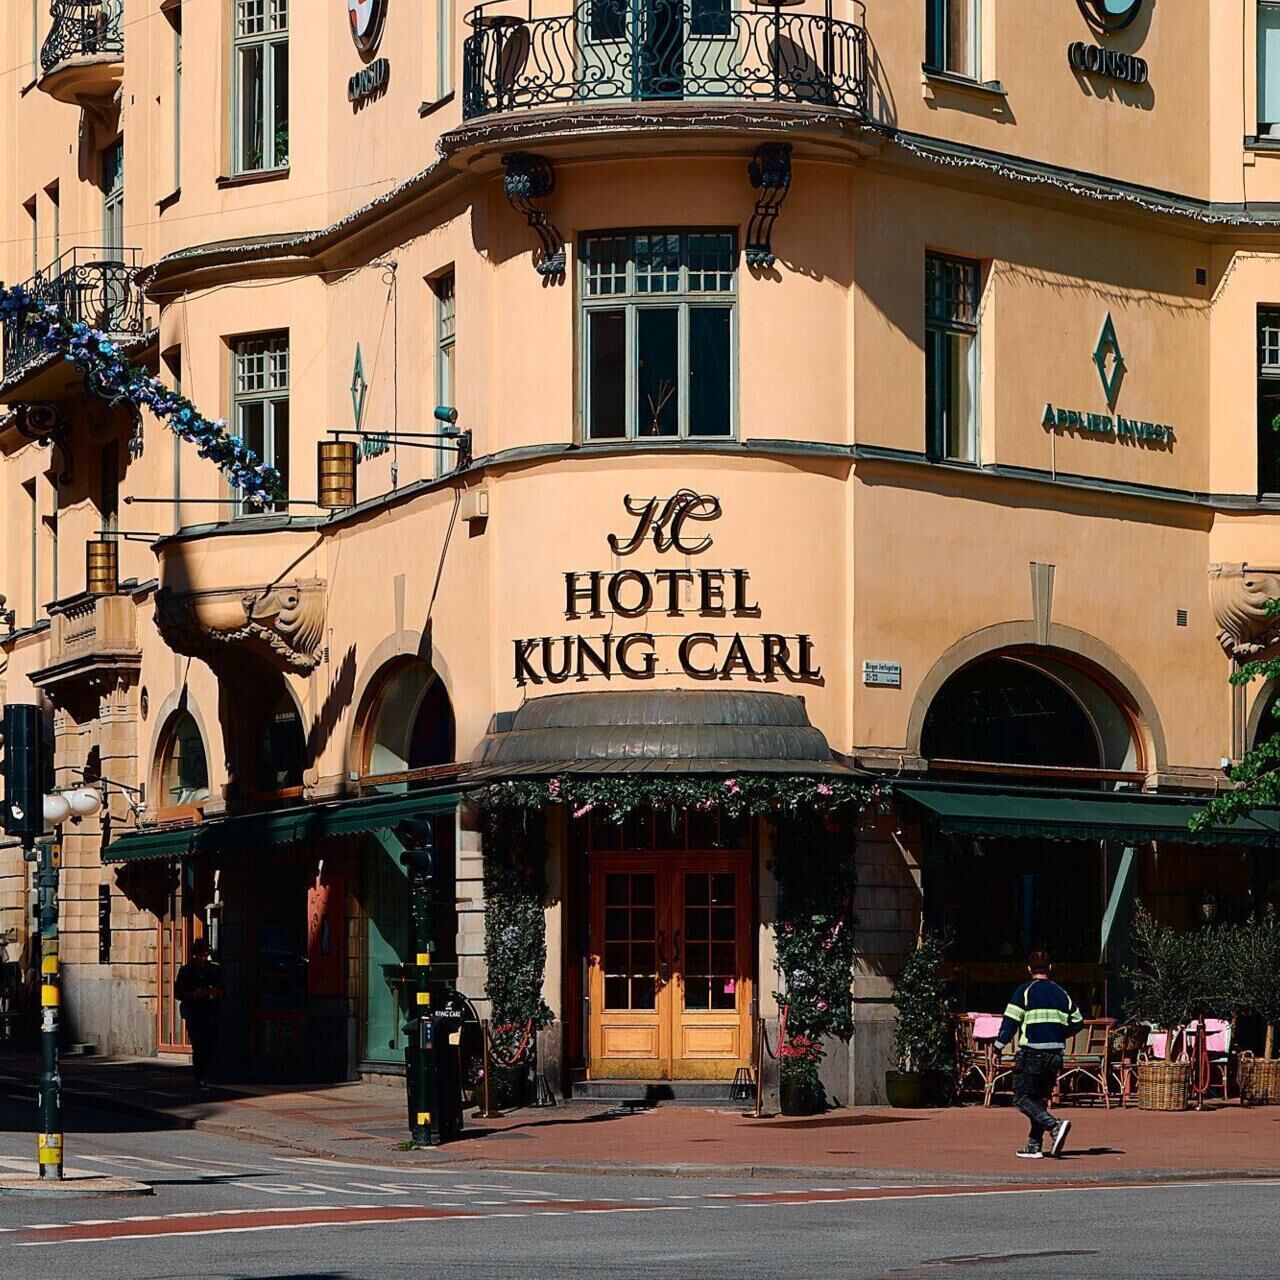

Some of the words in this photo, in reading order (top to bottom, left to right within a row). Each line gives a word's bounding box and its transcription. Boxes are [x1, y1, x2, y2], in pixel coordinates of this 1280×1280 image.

[1067, 41, 1148, 84] CONSID
[563, 568, 760, 619] HOTEL
[512, 633, 659, 685] KUNG
[678, 632, 823, 683] CARL
